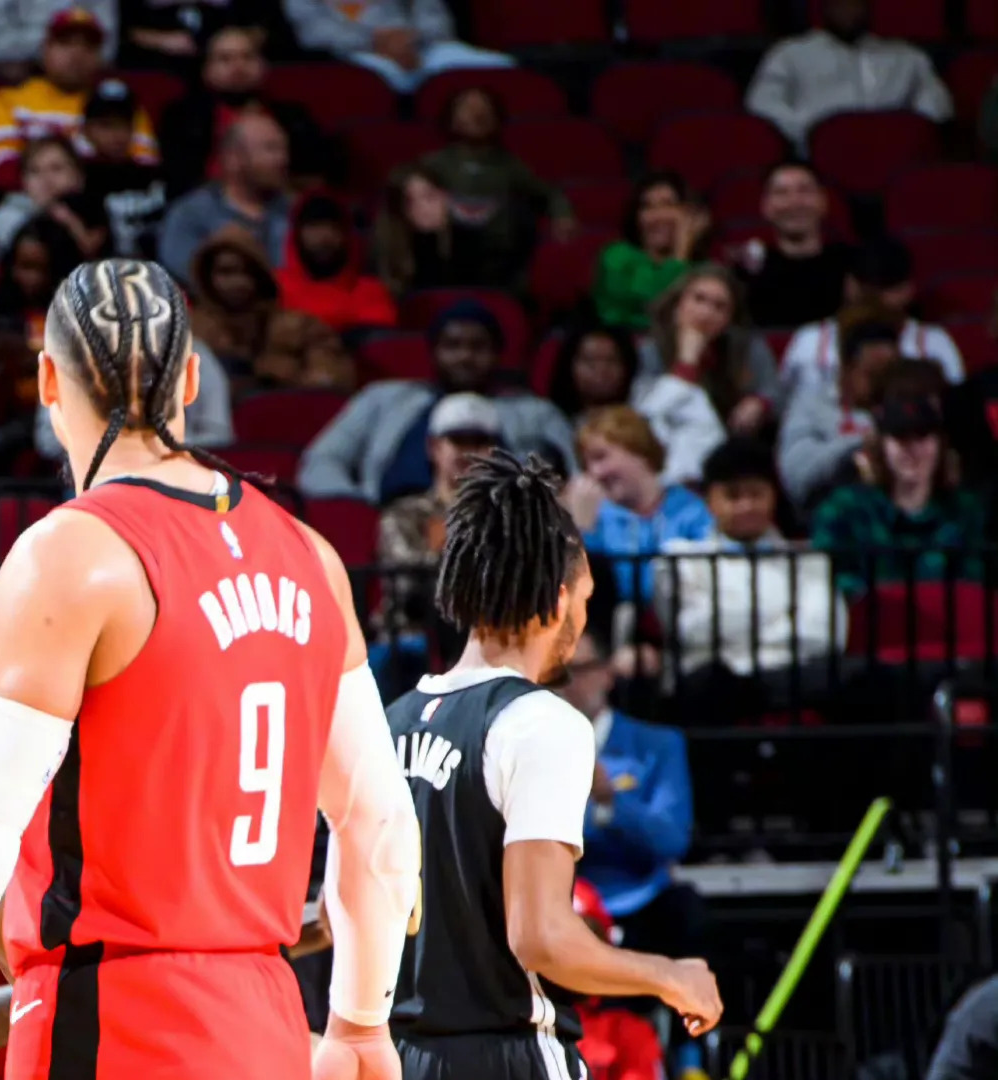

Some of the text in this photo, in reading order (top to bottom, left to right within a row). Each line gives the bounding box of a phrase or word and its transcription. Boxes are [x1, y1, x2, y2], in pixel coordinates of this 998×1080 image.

[198, 571, 312, 652] BROOKS
[229, 681, 286, 867] 9
[396, 731, 462, 791] LIAMS
